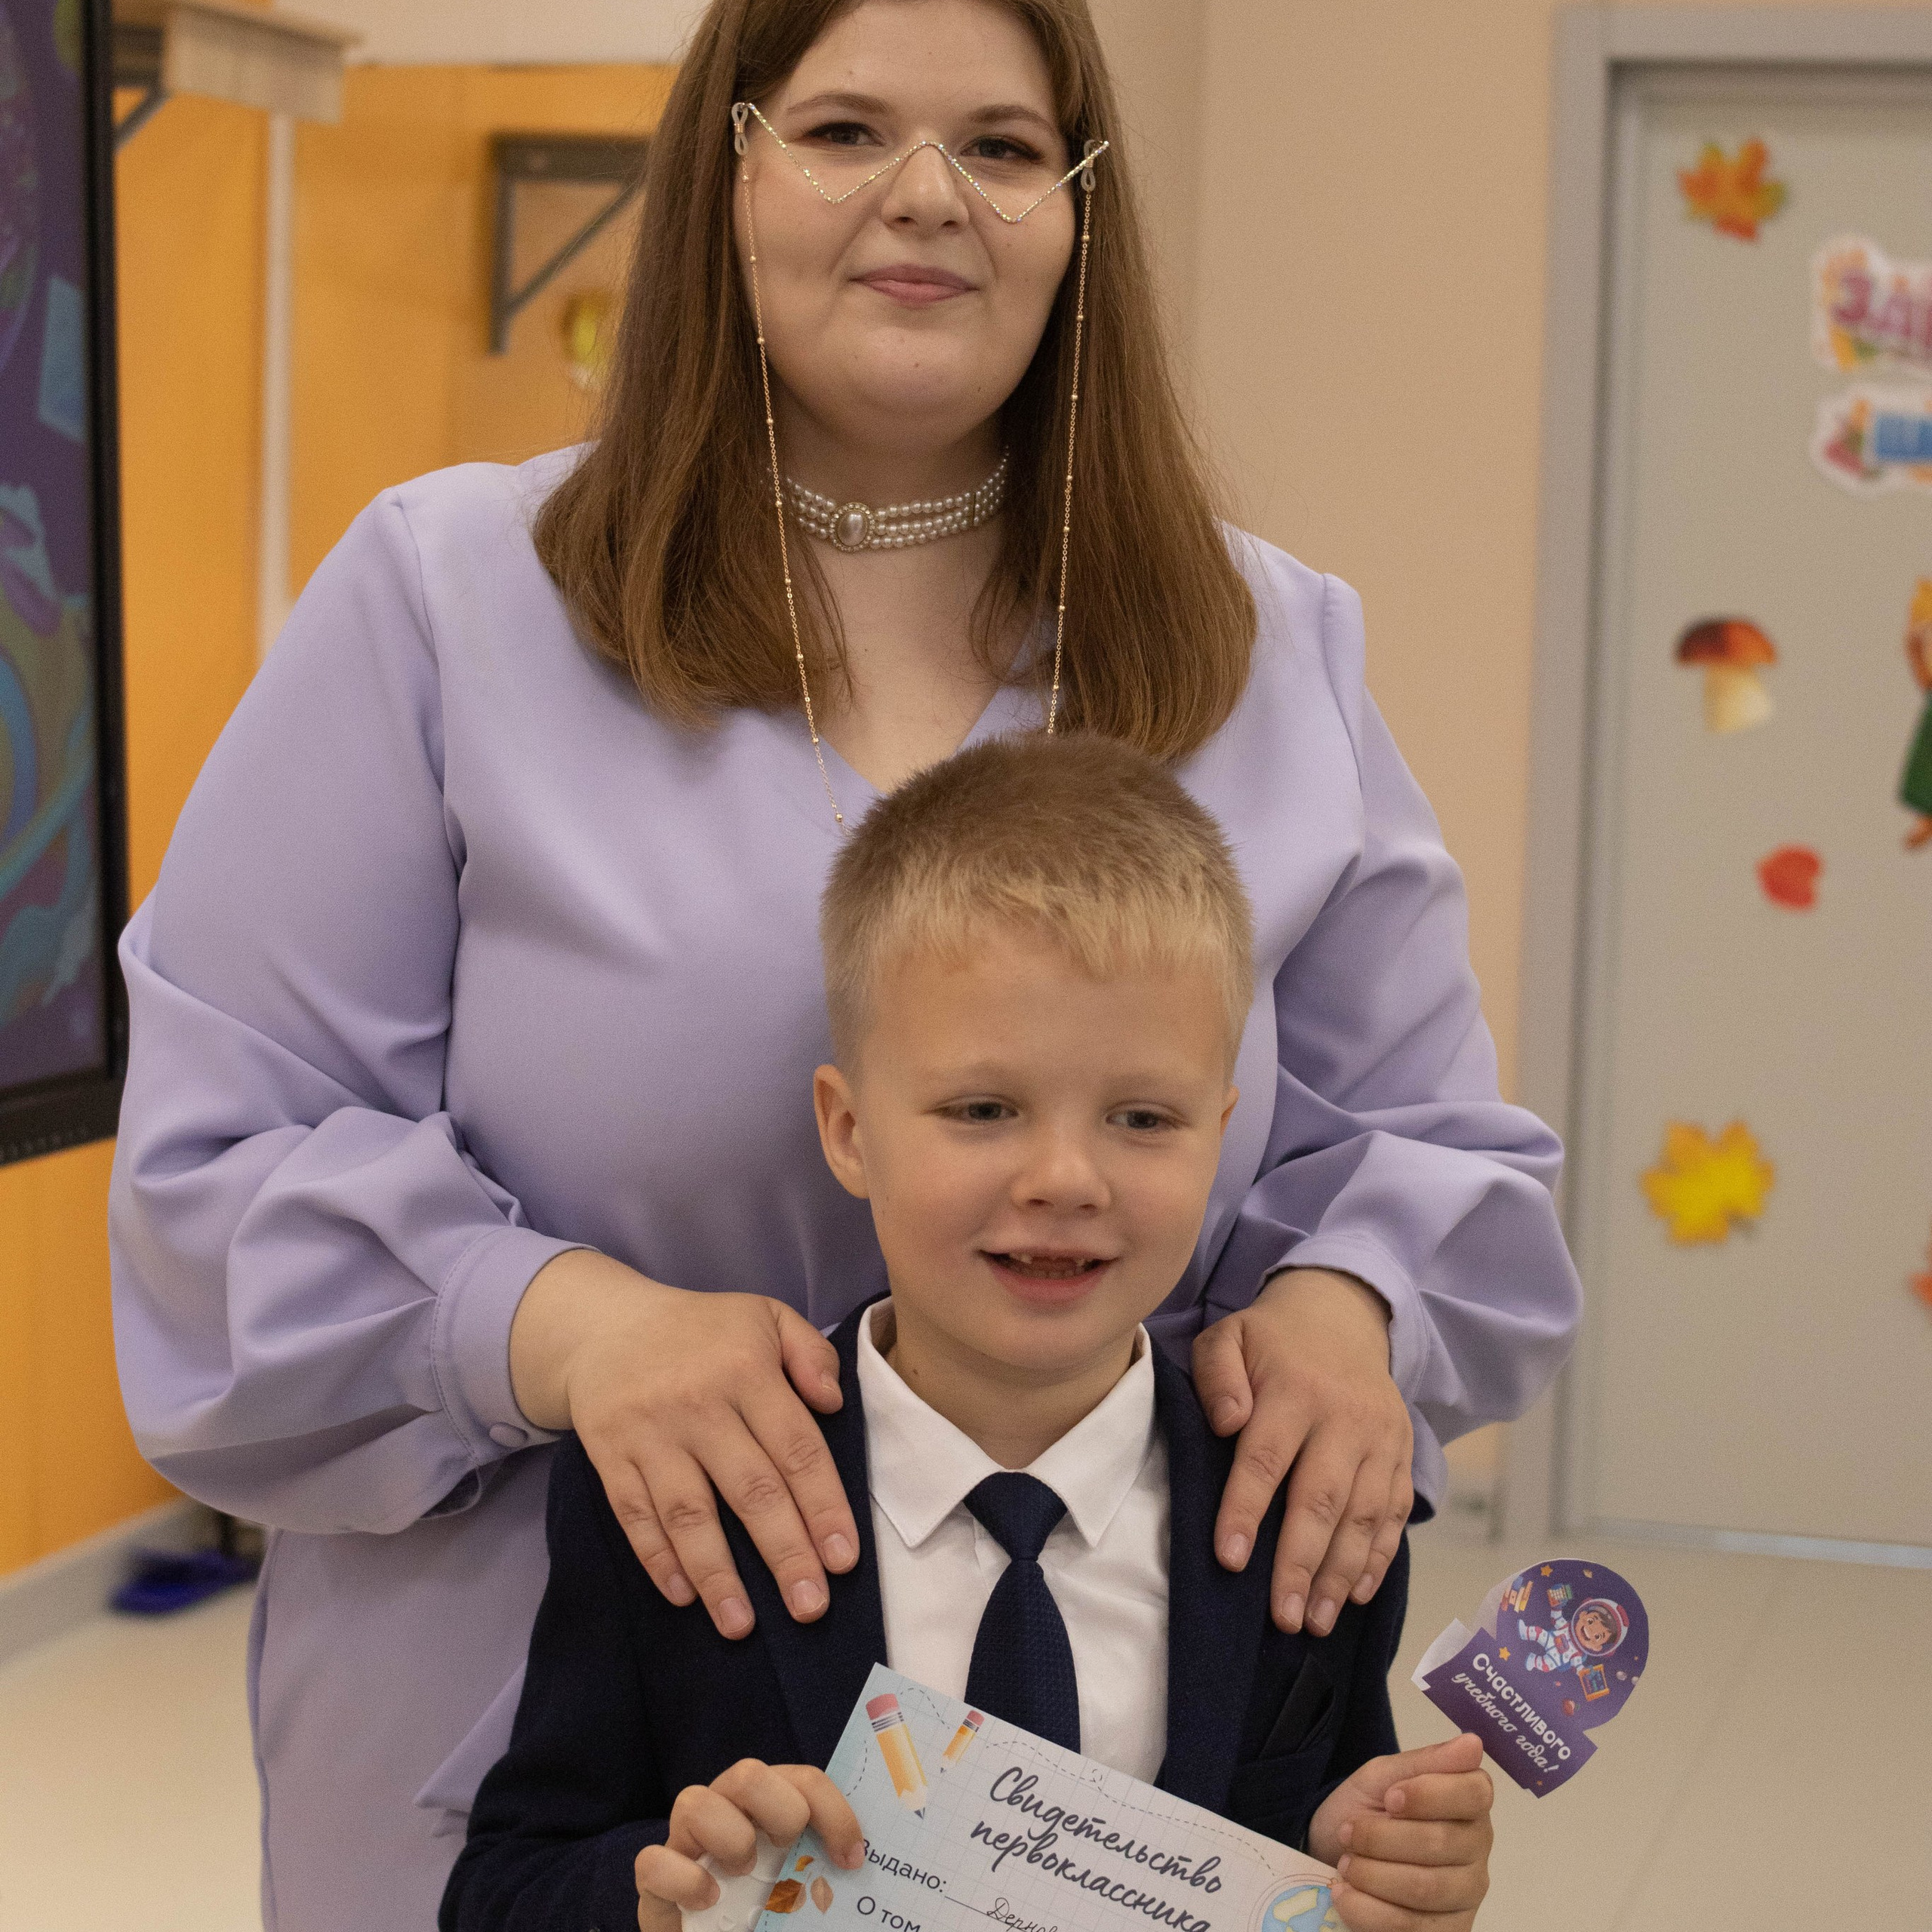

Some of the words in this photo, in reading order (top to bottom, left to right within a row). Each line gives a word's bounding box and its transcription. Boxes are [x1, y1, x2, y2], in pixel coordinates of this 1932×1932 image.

[1451, 1672, 1518, 1732] учебного
[1515, 1735, 1560, 1773] года!
[1472, 1653, 1571, 1760] Счастливого
[970, 1820, 1211, 1932] первоклассника
[989, 1766, 1223, 1894] Свидетельство
[857, 1896, 875, 1915] О
